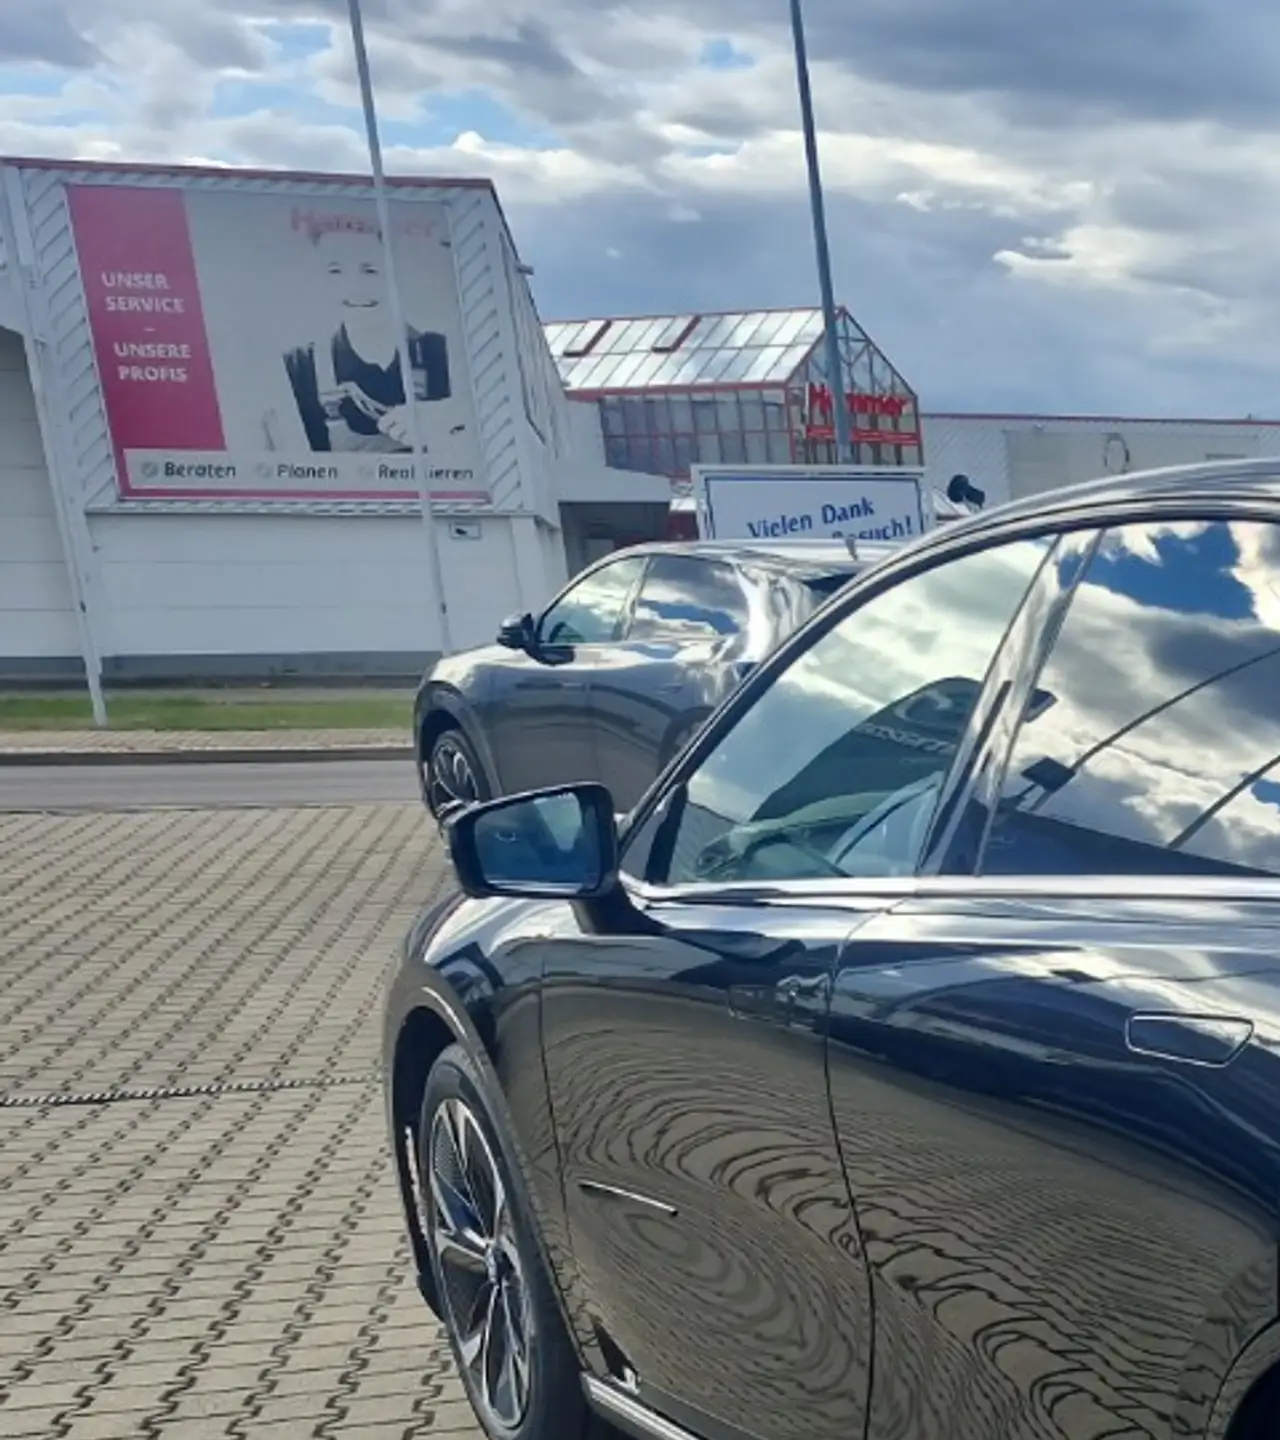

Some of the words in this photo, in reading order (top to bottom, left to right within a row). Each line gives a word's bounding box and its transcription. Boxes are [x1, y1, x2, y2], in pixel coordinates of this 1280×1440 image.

[101, 272, 171, 290] UNSER
[105, 296, 185, 313] SERVICE
[114, 342, 192, 358] UNSERE
[117, 365, 189, 382] PROFIS
[164, 461, 236, 479] Beraten
[277, 464, 338, 480] Planen
[747, 513, 813, 539] Vielen
[821, 496, 875, 525] Dank
